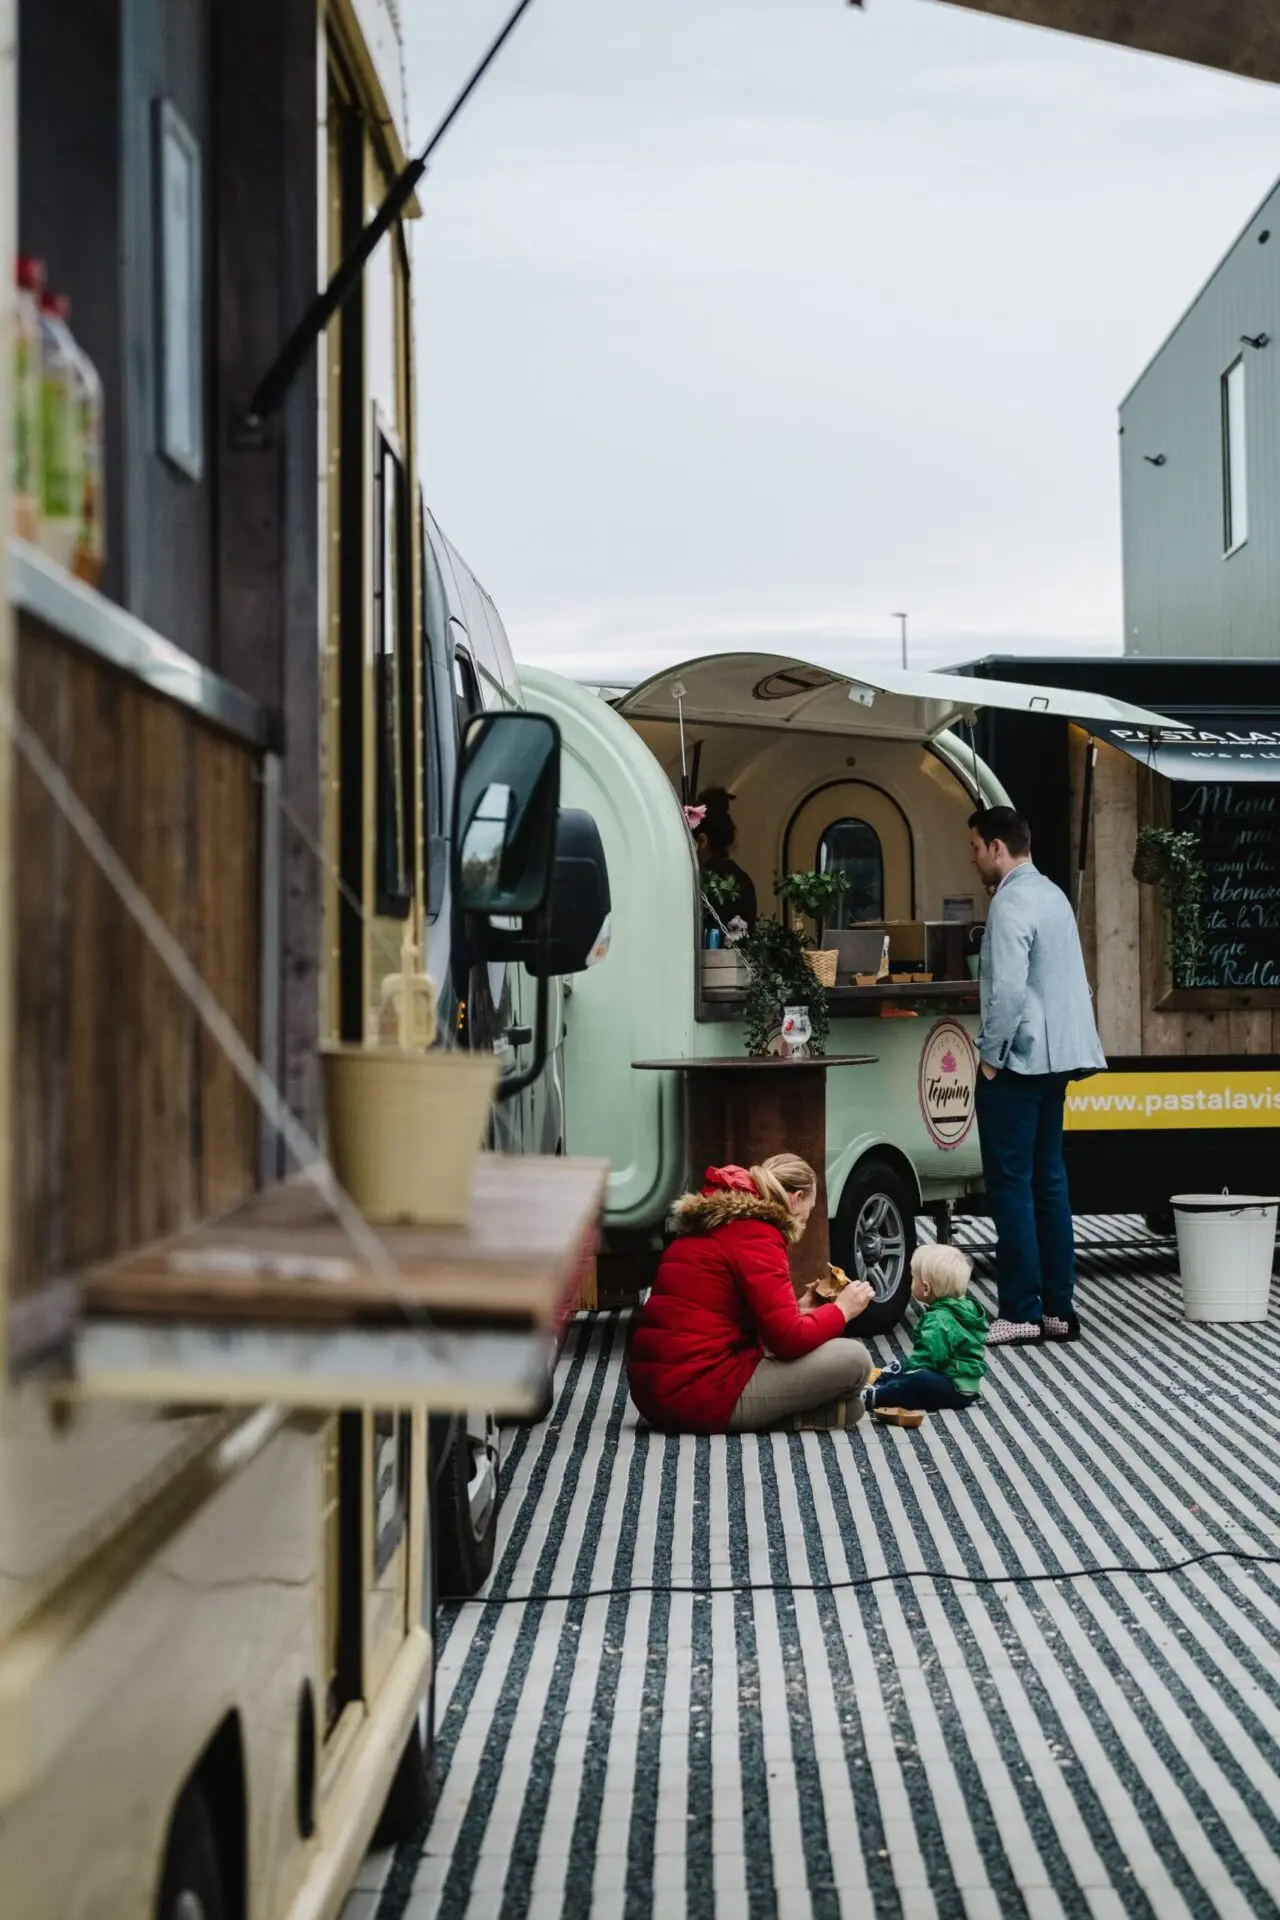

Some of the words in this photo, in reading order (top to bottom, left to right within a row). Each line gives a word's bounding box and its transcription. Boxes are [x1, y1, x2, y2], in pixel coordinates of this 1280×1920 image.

[1225, 731, 1276, 742] LA
[1178, 785, 1276, 816] Menu
[926, 1076, 970, 1108] Topping
